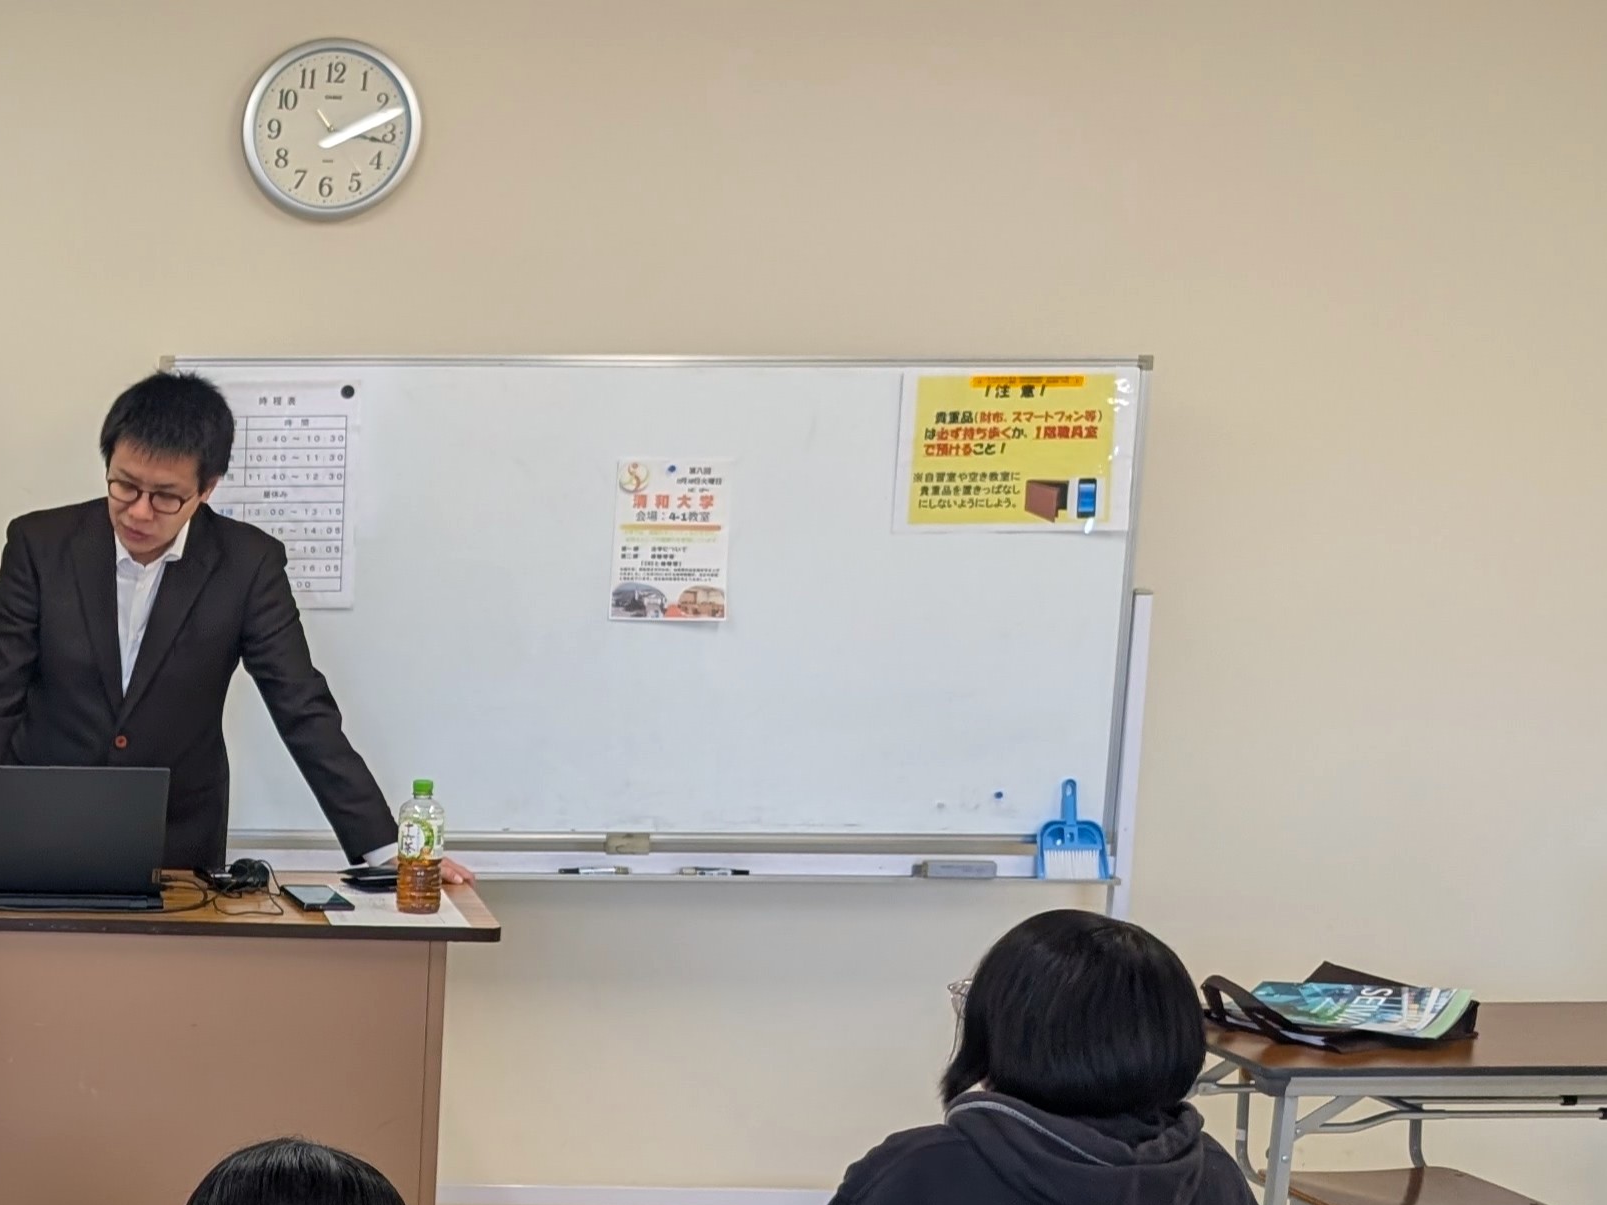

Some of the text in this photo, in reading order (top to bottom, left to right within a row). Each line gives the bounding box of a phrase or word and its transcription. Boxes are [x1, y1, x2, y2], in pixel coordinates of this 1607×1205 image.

[299, 68, 317, 90] 11
[325, 62, 347, 84] 12
[360, 70, 369, 92] 1
[277, 88, 299, 111] 10
[376, 92, 391, 109] 2
[266, 118, 282, 140] 9
[381, 123, 396, 144] 3
[274, 147, 289, 168] 8
[369, 150, 383, 170] 4
[293, 169, 308, 190] 7
[318, 176, 333, 198] 6
[348, 173, 362, 193] 5
[920, 485, 1021, 496] 貴重品を置きっぱなし
[918, 498, 1017, 509] にしないようにしよう。
